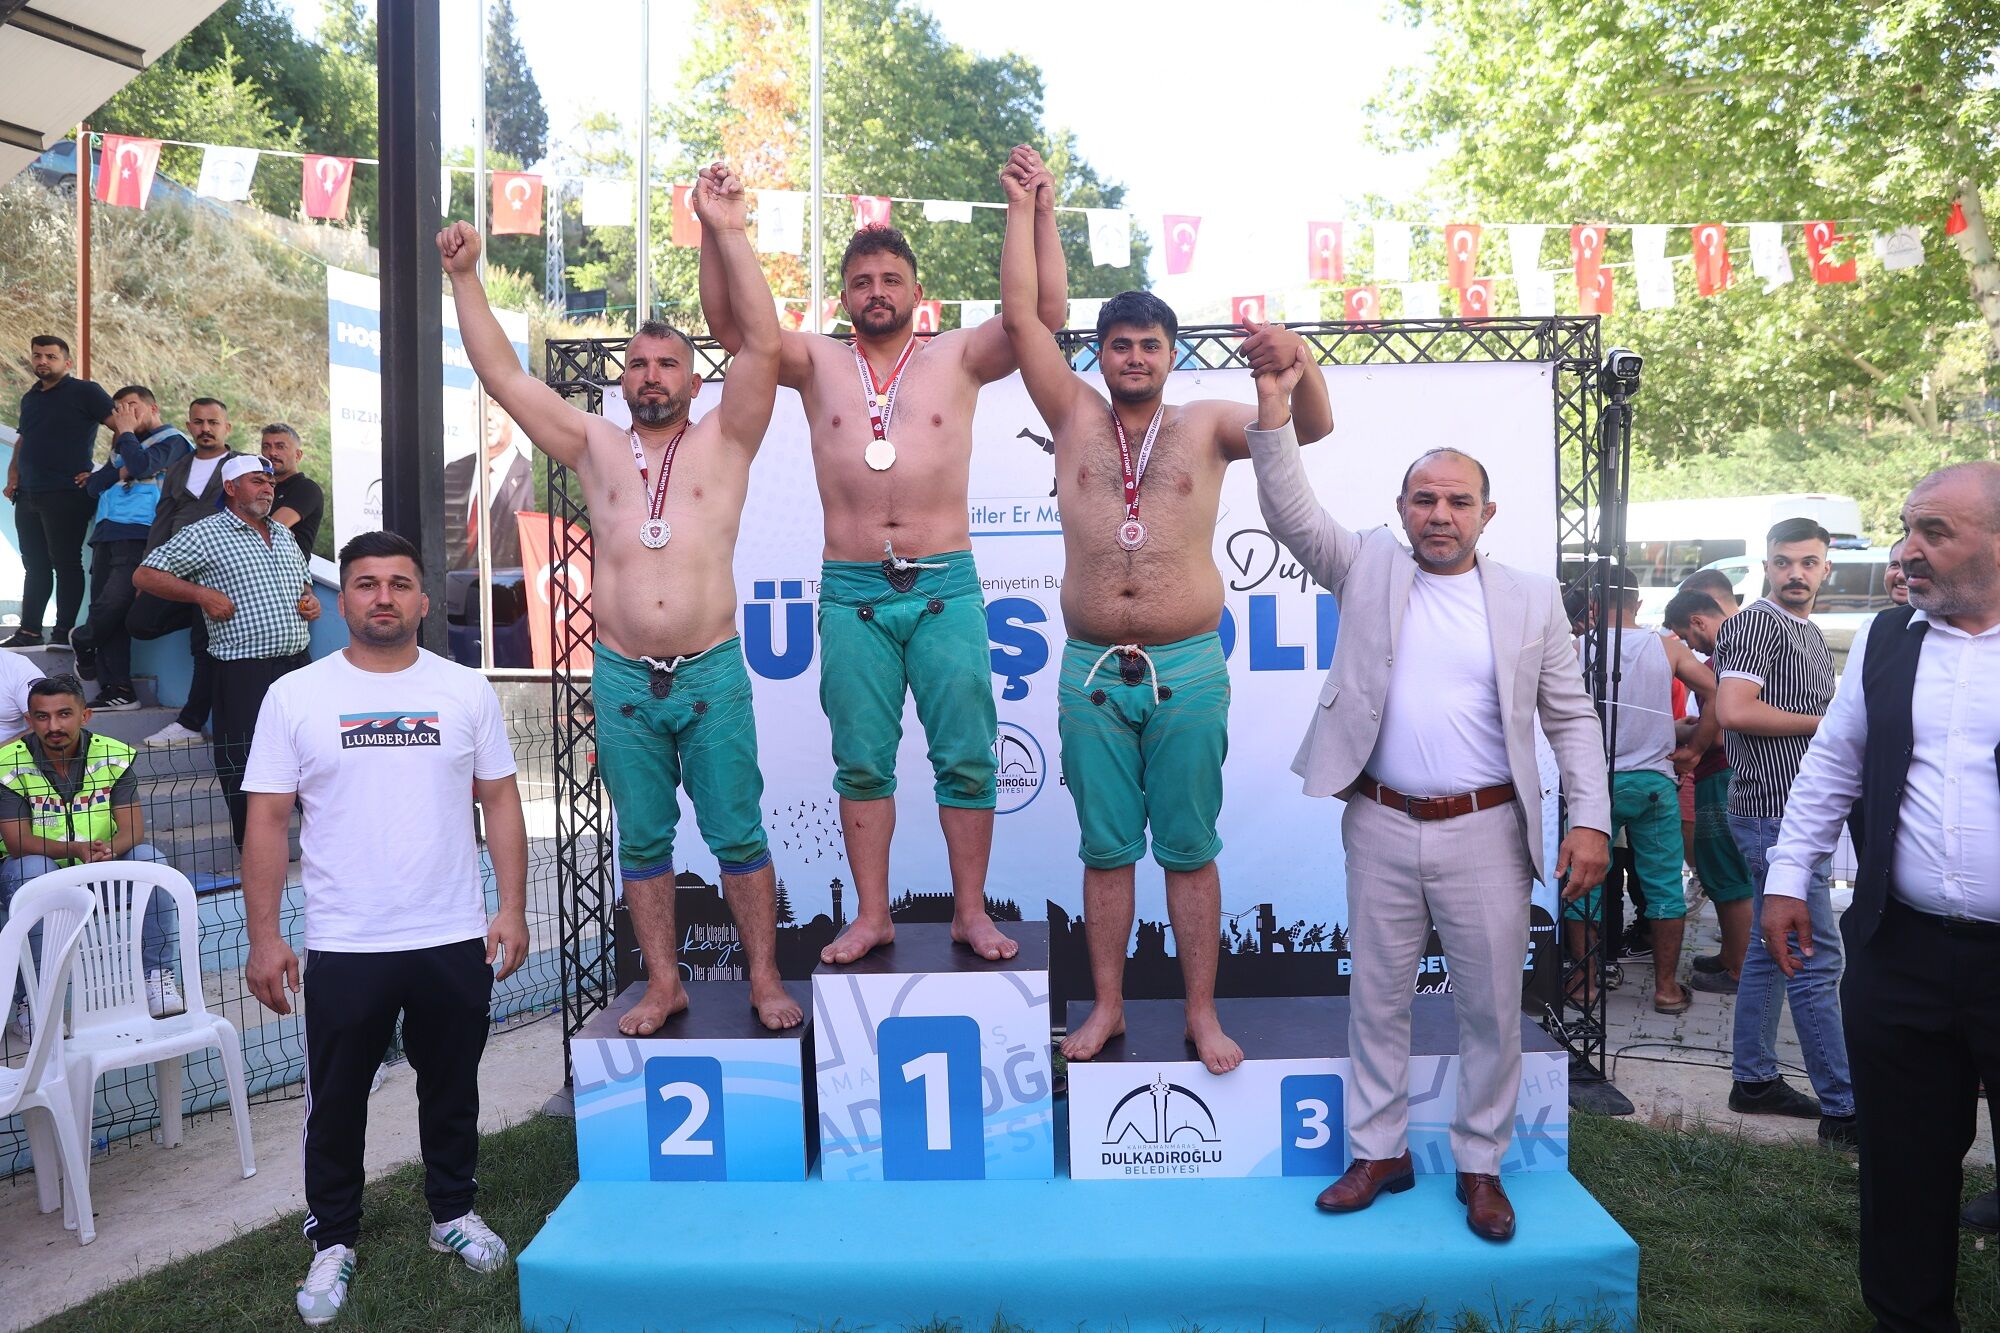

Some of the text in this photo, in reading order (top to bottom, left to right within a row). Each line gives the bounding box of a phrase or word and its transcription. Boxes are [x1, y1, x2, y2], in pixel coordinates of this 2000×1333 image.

[971, 506, 1006, 524] itler
[1013, 505, 1031, 523] Er
[979, 576, 1040, 592] eniyetin
[345, 732, 438, 746] LUMBERJACK
[996, 777, 1038, 787] DİROĞLU
[694, 923, 706, 942] Her
[694, 964, 705, 981] Her
[901, 1052, 951, 1150] 1
[658, 1081, 714, 1156] 2
[1294, 1098, 1331, 1149] 3
[1101, 1148, 1222, 1165] DULKADİROĞLU
[1125, 1164, 1200, 1175] BELEDİYESİ
